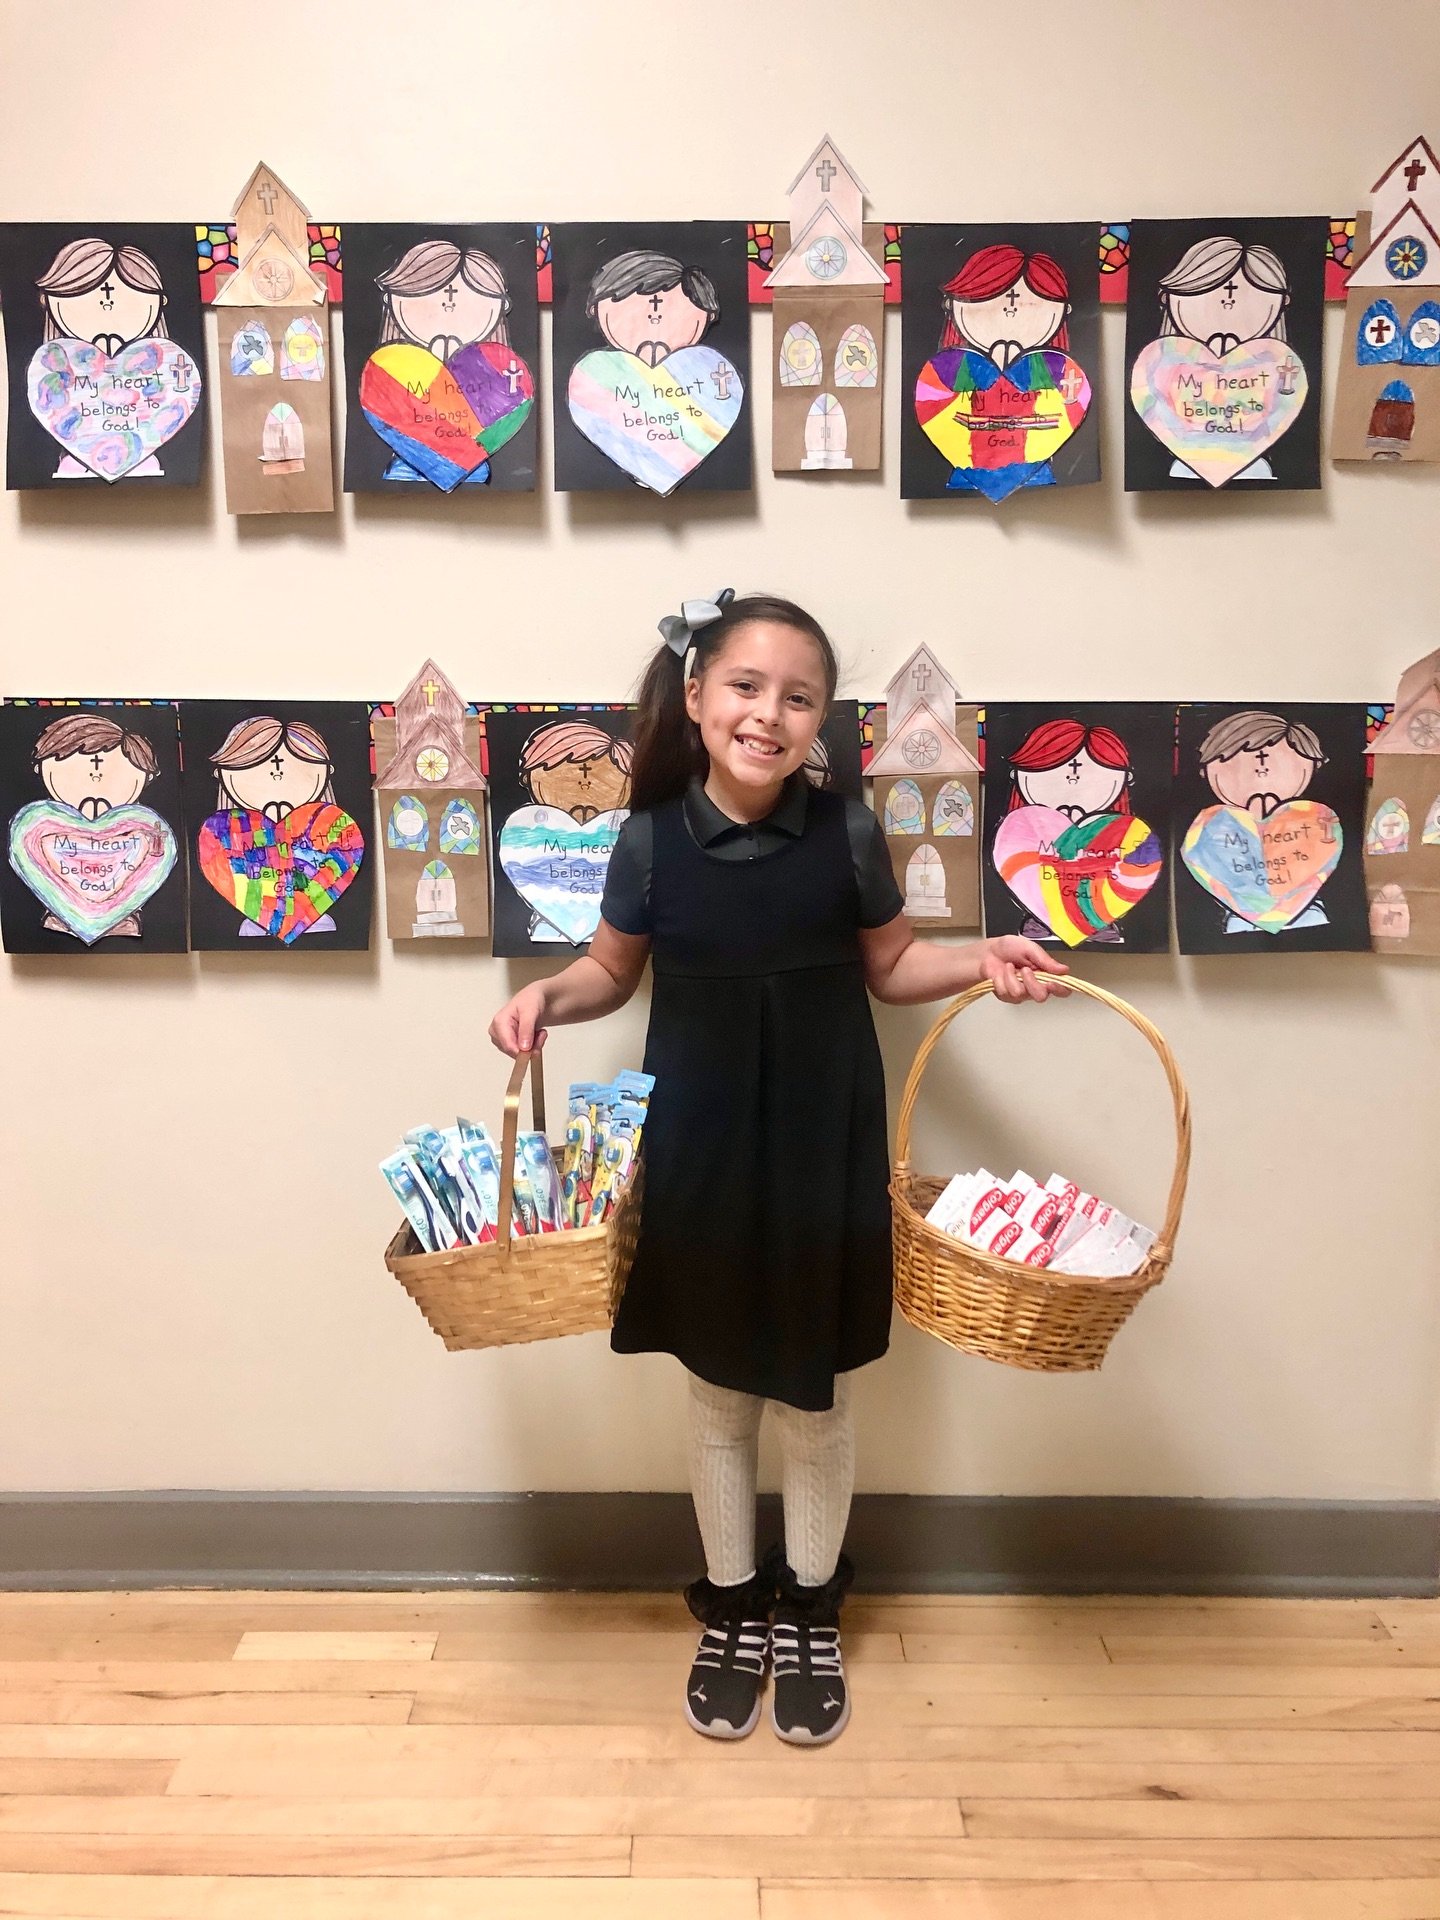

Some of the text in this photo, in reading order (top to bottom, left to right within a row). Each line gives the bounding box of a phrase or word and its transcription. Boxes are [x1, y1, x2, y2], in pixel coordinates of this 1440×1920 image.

[74, 370, 163, 398] My heart
[407, 381, 431, 404] My
[615, 378, 704, 408] My heart
[1178, 370, 1270, 398] My heart
[81, 397, 160, 417] belongs to
[413, 407, 469, 423] belongs
[623, 405, 702, 427] belongs to
[1184, 398, 1264, 418] belongs to
[102, 416, 140, 431] God!
[434, 422, 472, 438] God!
[647, 425, 685, 441] God!
[1205, 418, 1244, 434] God!
[54, 834, 140, 857] My heart
[543, 838, 615, 861] My hea
[1224, 824, 1311, 854] My heart
[60, 858, 135, 877] belongs to
[311, 856, 326, 868] to
[1232, 849, 1309, 873] belongs to
[549, 864, 602, 880] belongs
[1255, 869, 1292, 886] God!
[80, 878, 116, 893] God!
[971, 1190, 1002, 1226] Colgate
[1004, 1191, 1022, 1214] Colg
[1034, 1203, 1057, 1233] Colga
[1031, 1244, 1050, 1265] Colg
